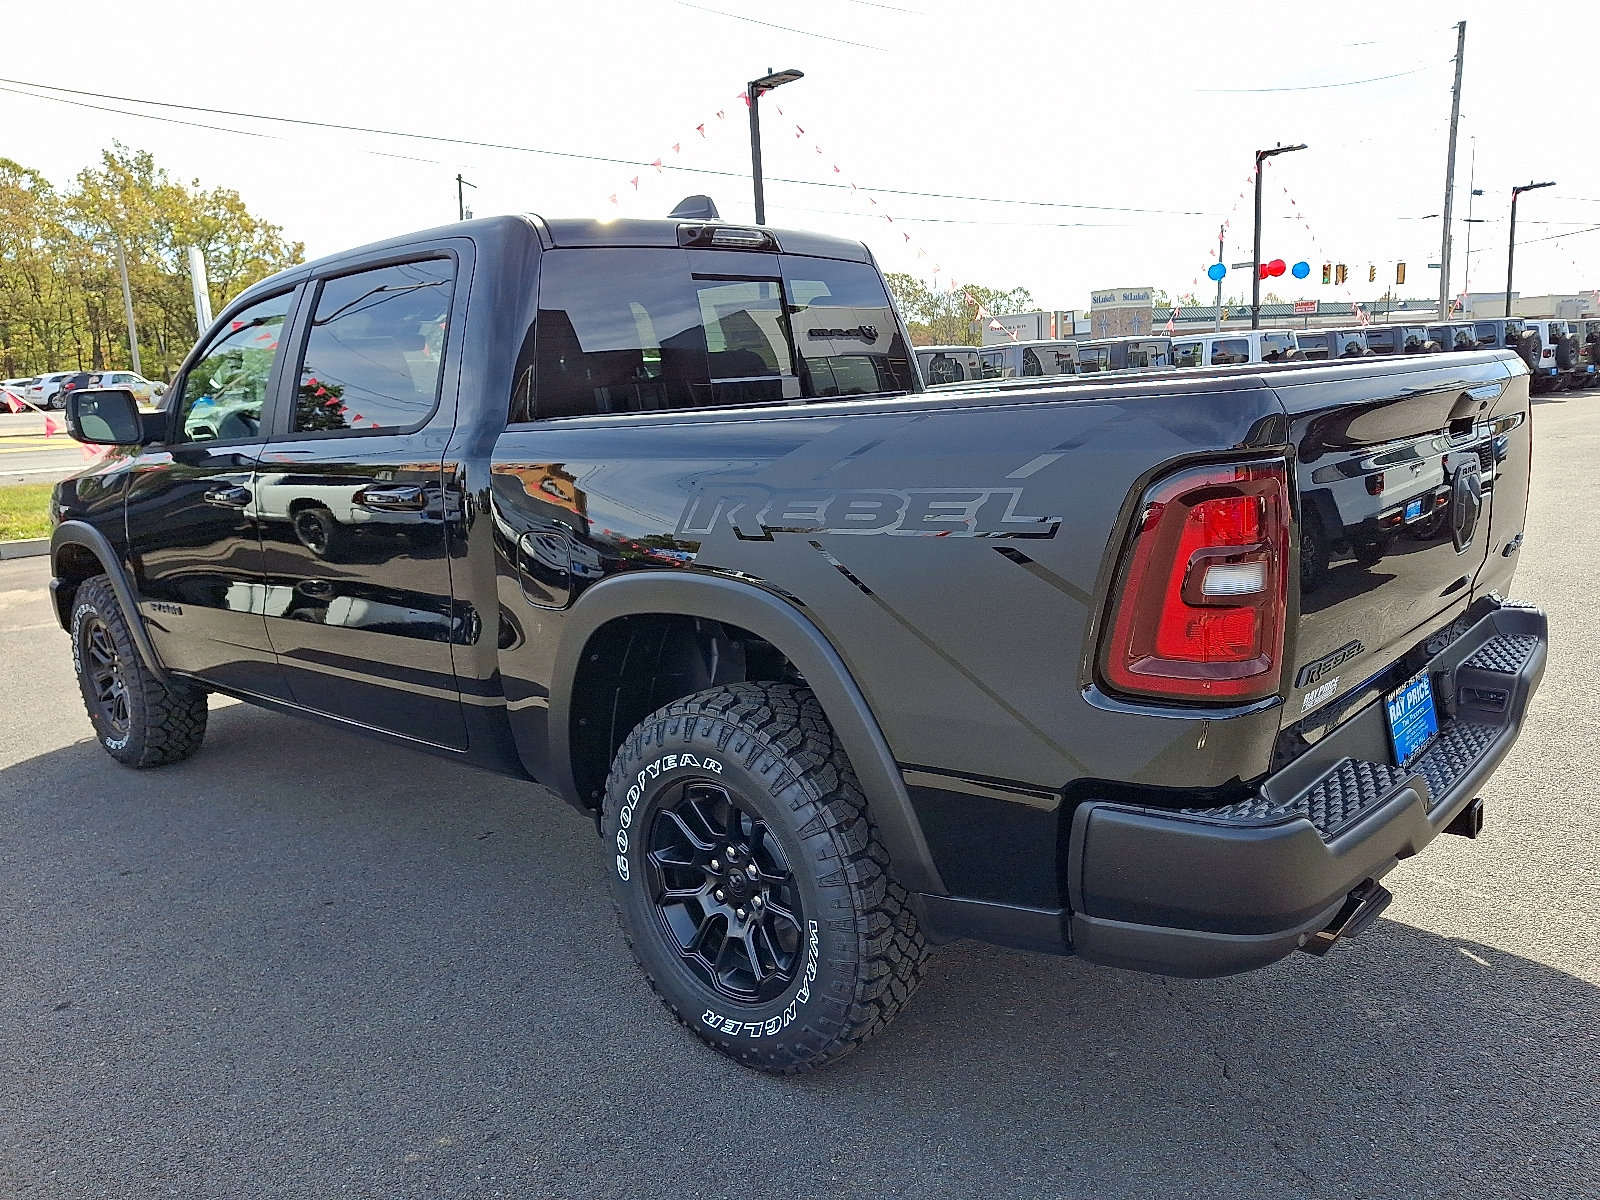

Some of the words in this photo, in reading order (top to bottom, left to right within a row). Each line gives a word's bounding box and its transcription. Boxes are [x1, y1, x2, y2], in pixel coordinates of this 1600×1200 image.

[1462, 464, 1476, 475] RAM
[677, 482, 1063, 541] REBEL
[1295, 639, 1365, 689] REBEL
[1389, 695, 1407, 723] RAY
[1407, 679, 1430, 709] PRICE
[616, 753, 723, 881] GOODYEAR
[701, 920, 819, 1038] WRANGLER
